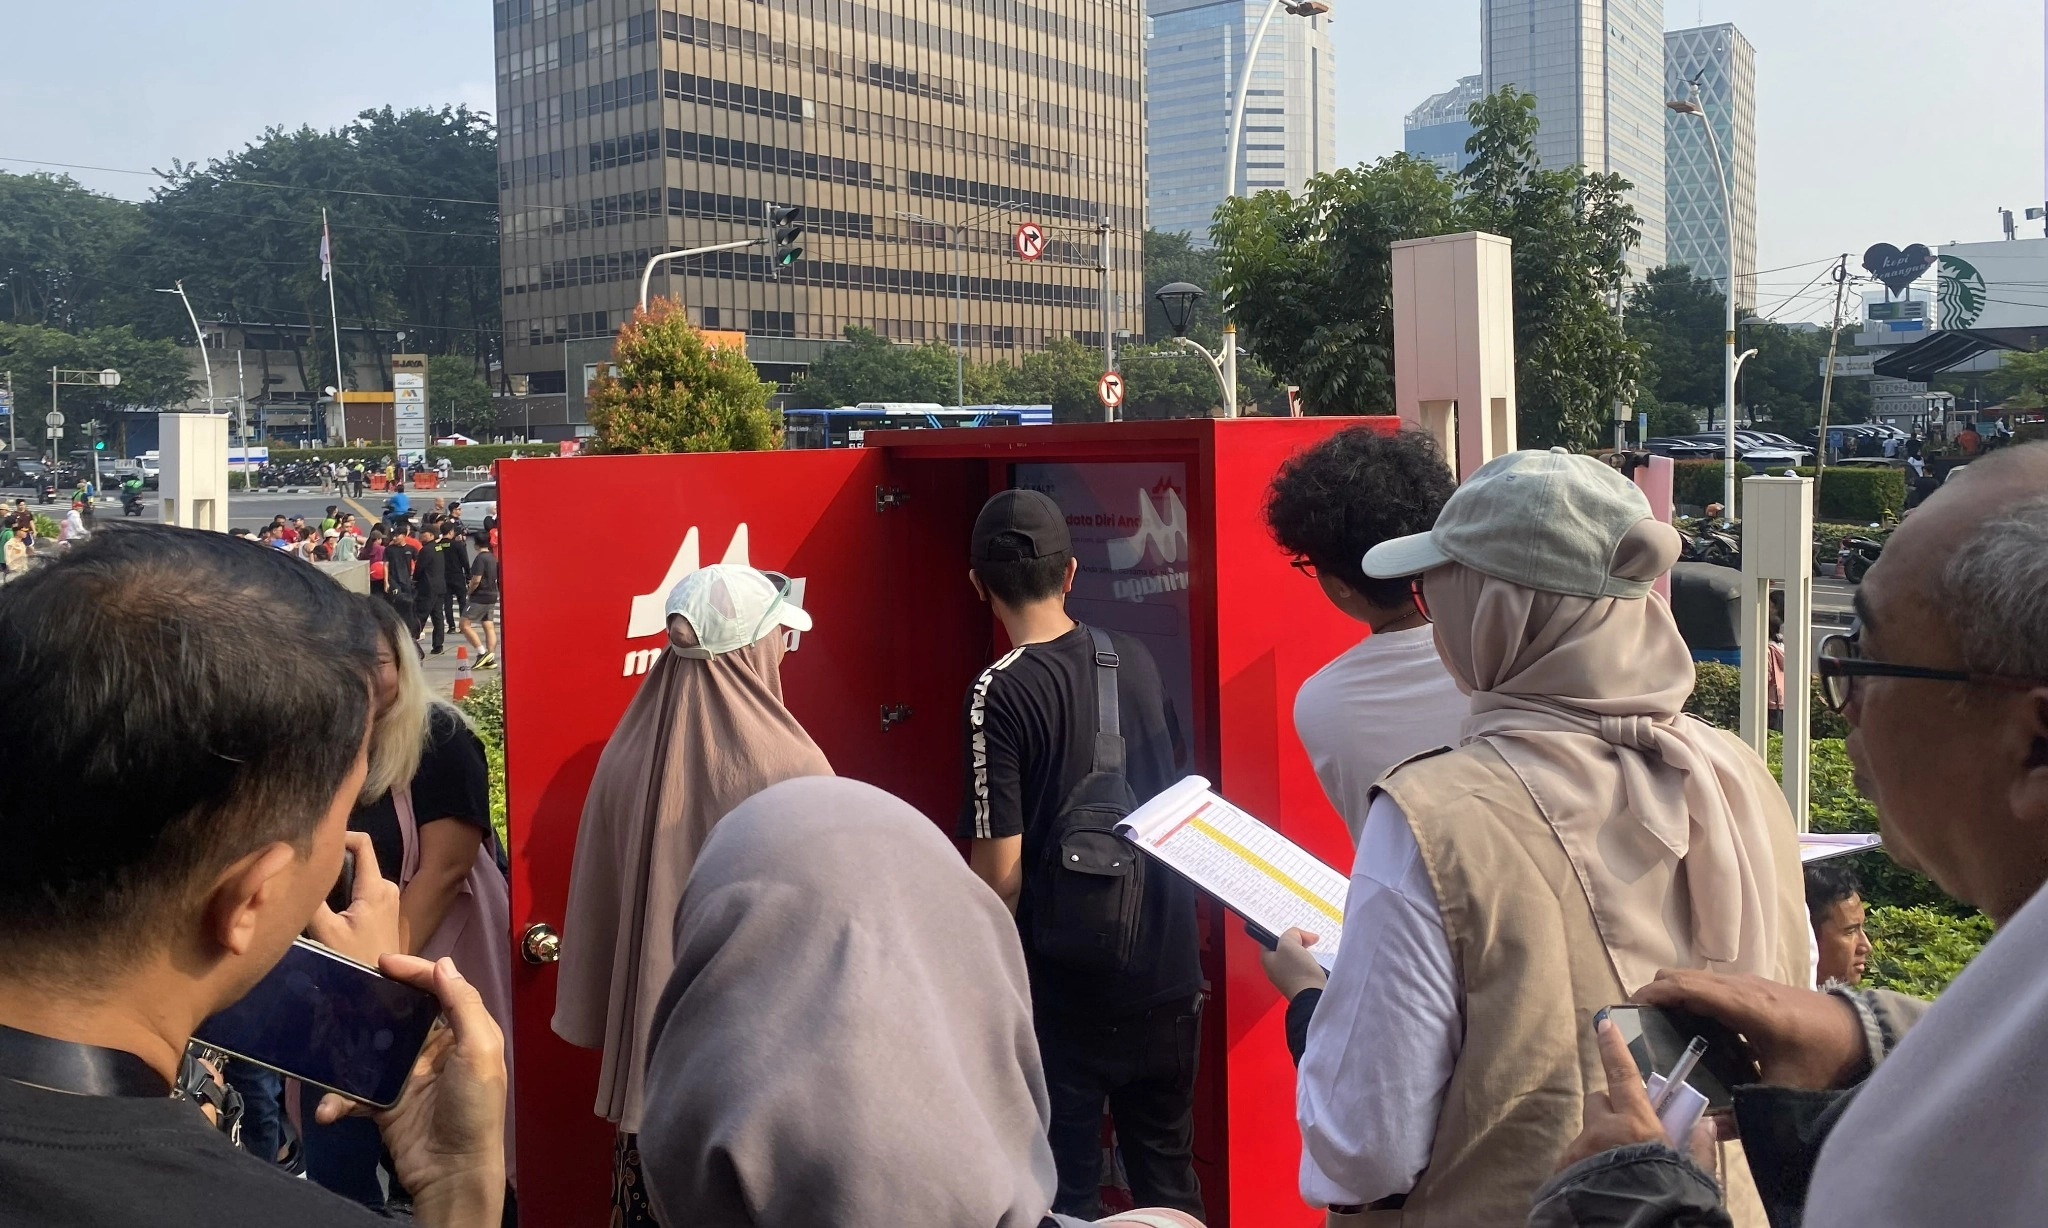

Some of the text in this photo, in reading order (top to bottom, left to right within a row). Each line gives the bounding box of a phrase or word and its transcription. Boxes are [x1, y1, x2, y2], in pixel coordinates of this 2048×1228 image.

[1883, 254, 1910, 268] kopi
[1095, 514, 1115, 527] Diri
[970, 668, 994, 800] STAR WARS
